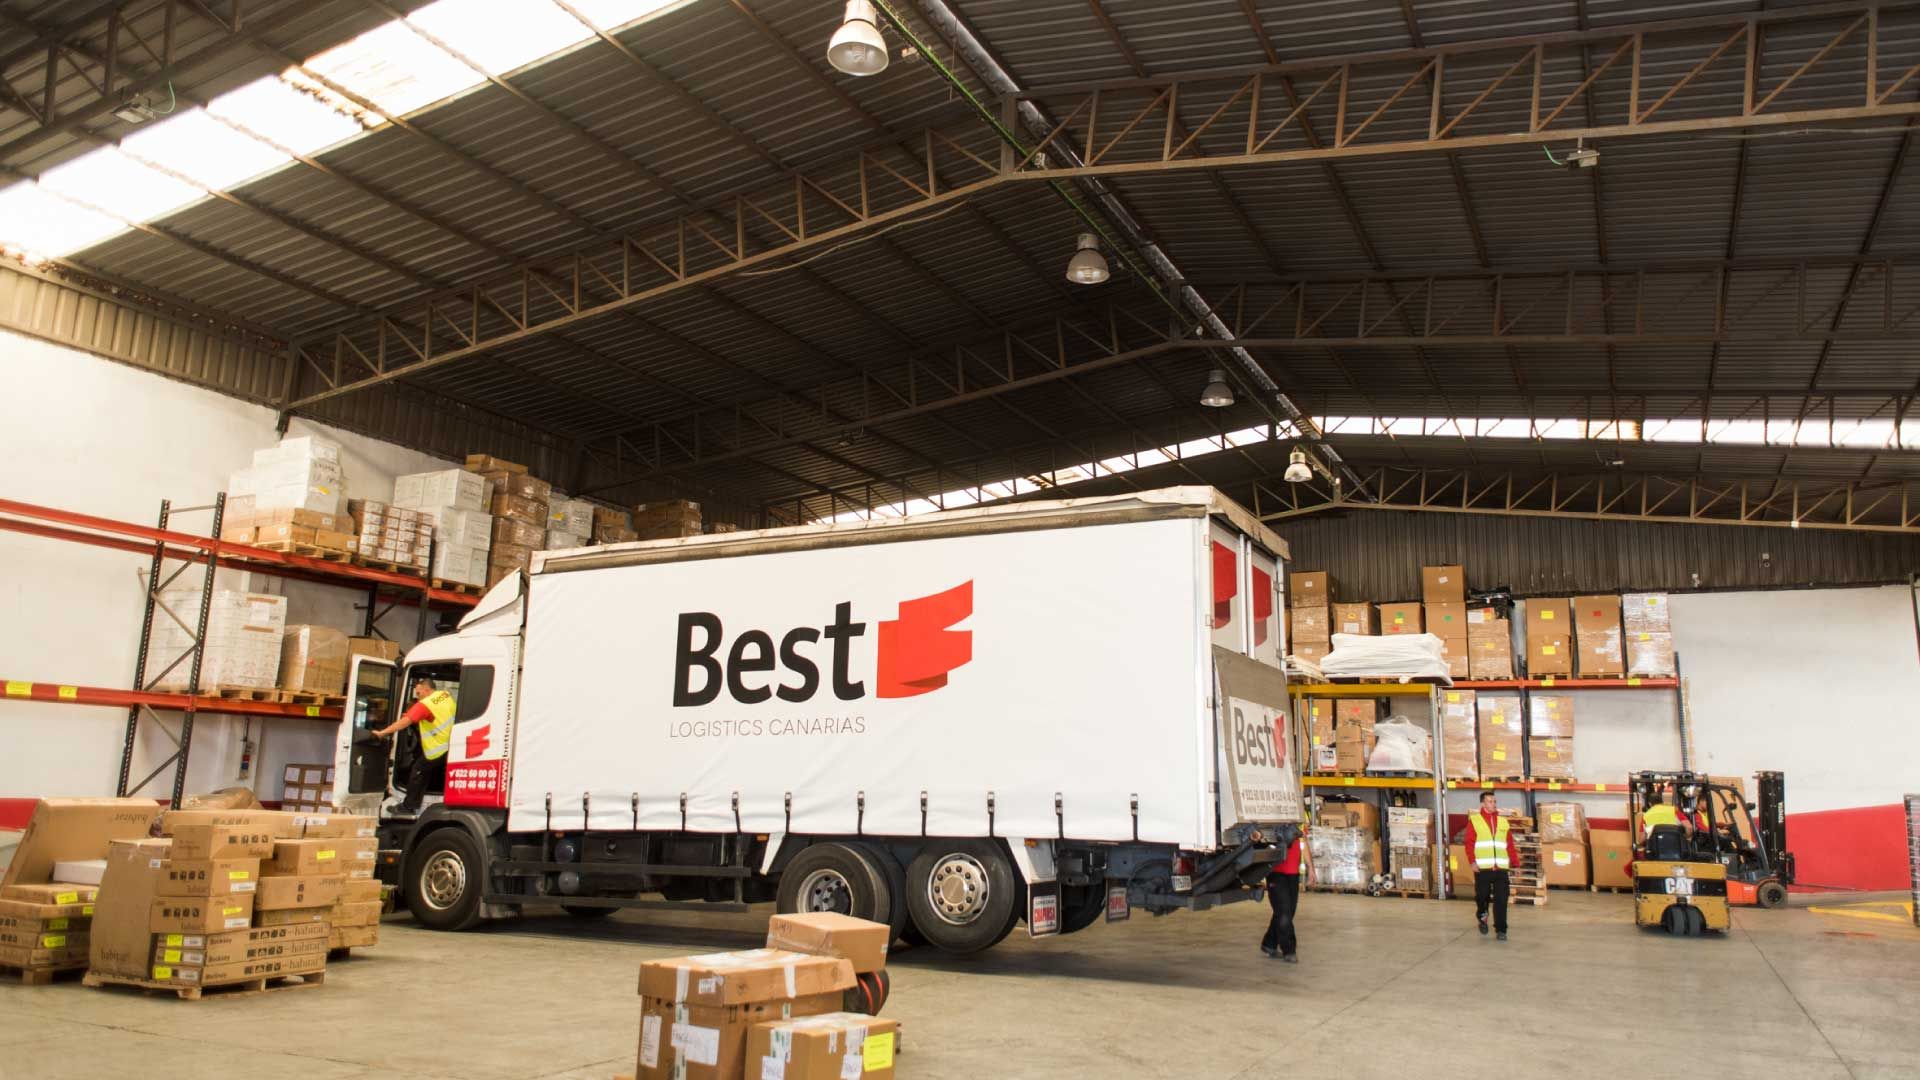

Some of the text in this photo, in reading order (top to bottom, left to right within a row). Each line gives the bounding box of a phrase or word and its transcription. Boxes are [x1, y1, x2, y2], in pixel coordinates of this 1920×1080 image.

[672, 600, 867, 708] Best
[669, 716, 866, 738] LOGISTICS CANARIAS
[1233, 706, 1276, 768] Best
[1664, 877, 1695, 895] CAT
